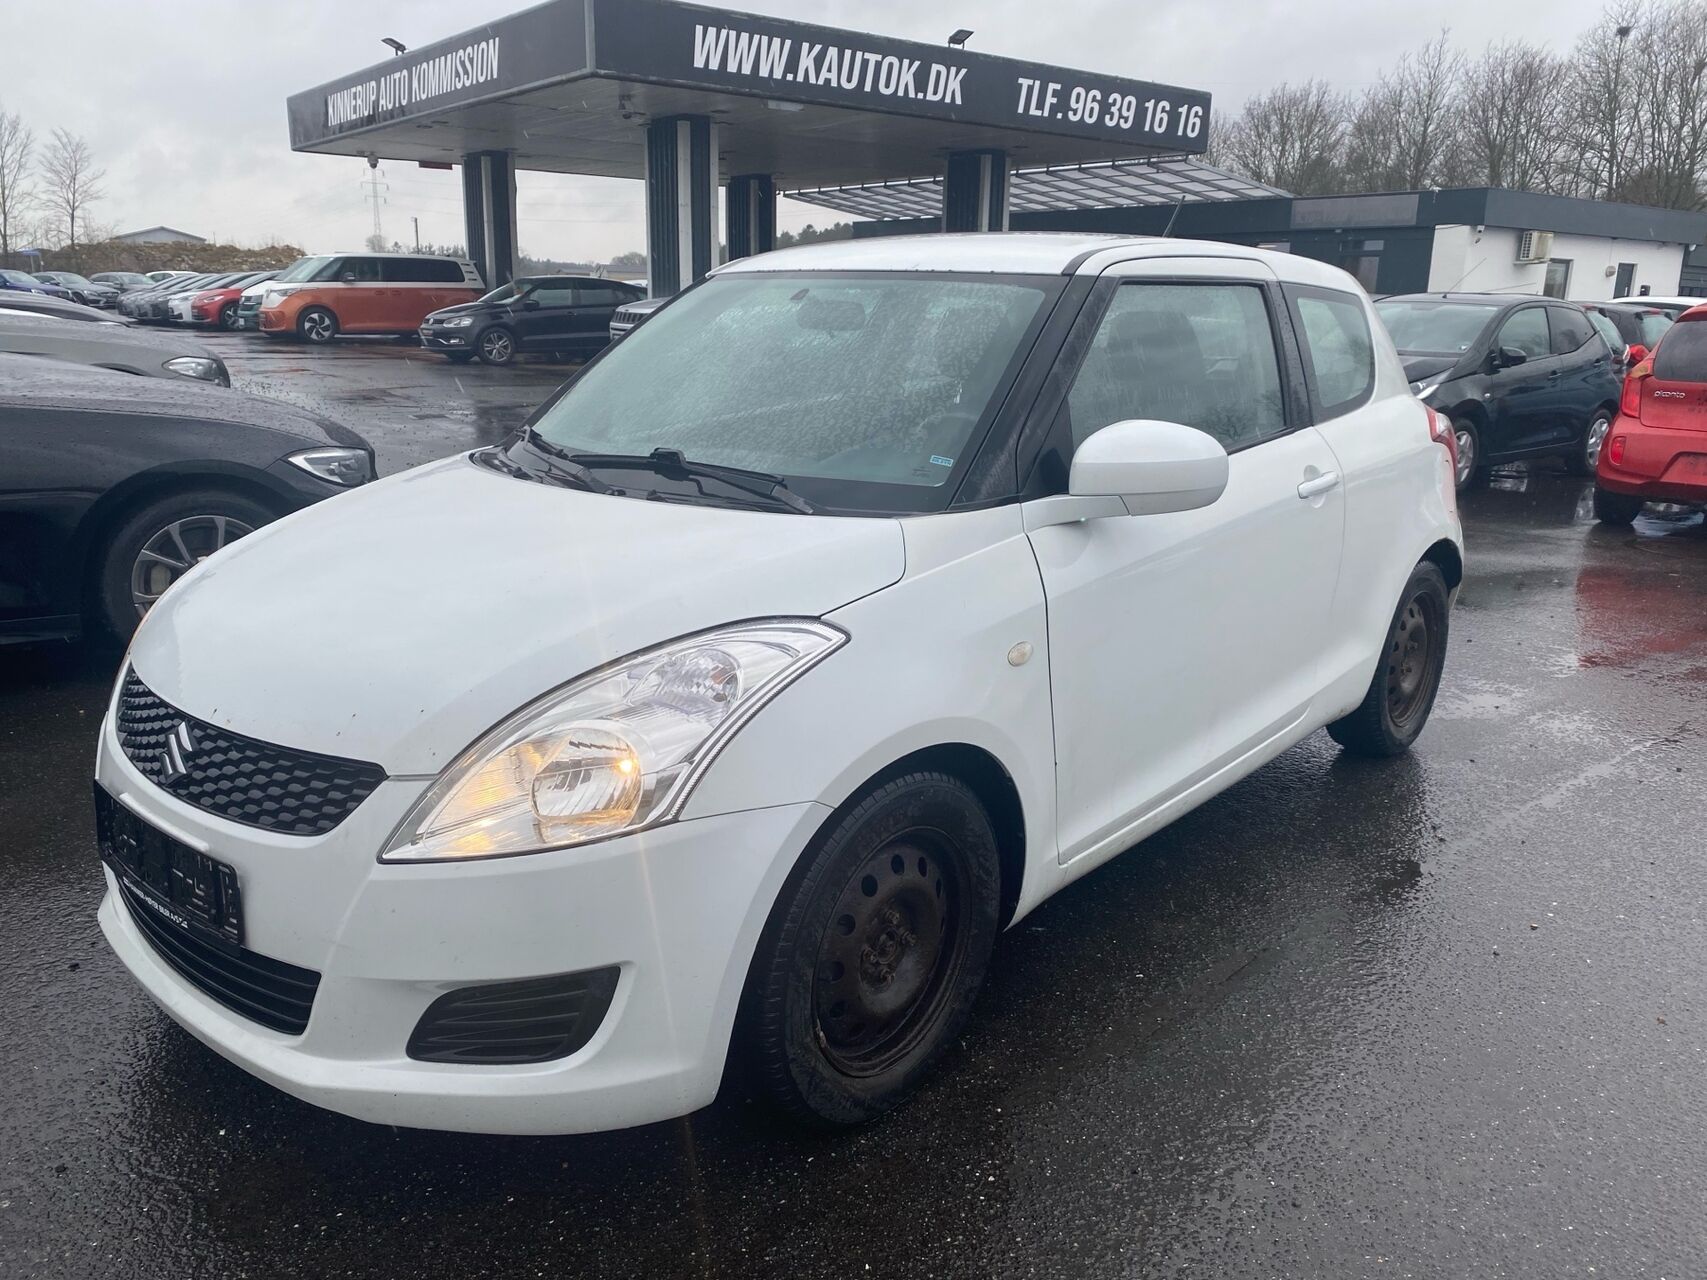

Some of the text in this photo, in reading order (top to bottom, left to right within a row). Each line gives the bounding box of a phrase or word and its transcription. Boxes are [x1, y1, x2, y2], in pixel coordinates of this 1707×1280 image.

[328, 37, 499, 126] KINNERUP AUTO KOMMISSION
[693, 25, 967, 105] WWW.KAUTOK.DK
[1017, 78, 1202, 138] TLF. 96 39 16 16
